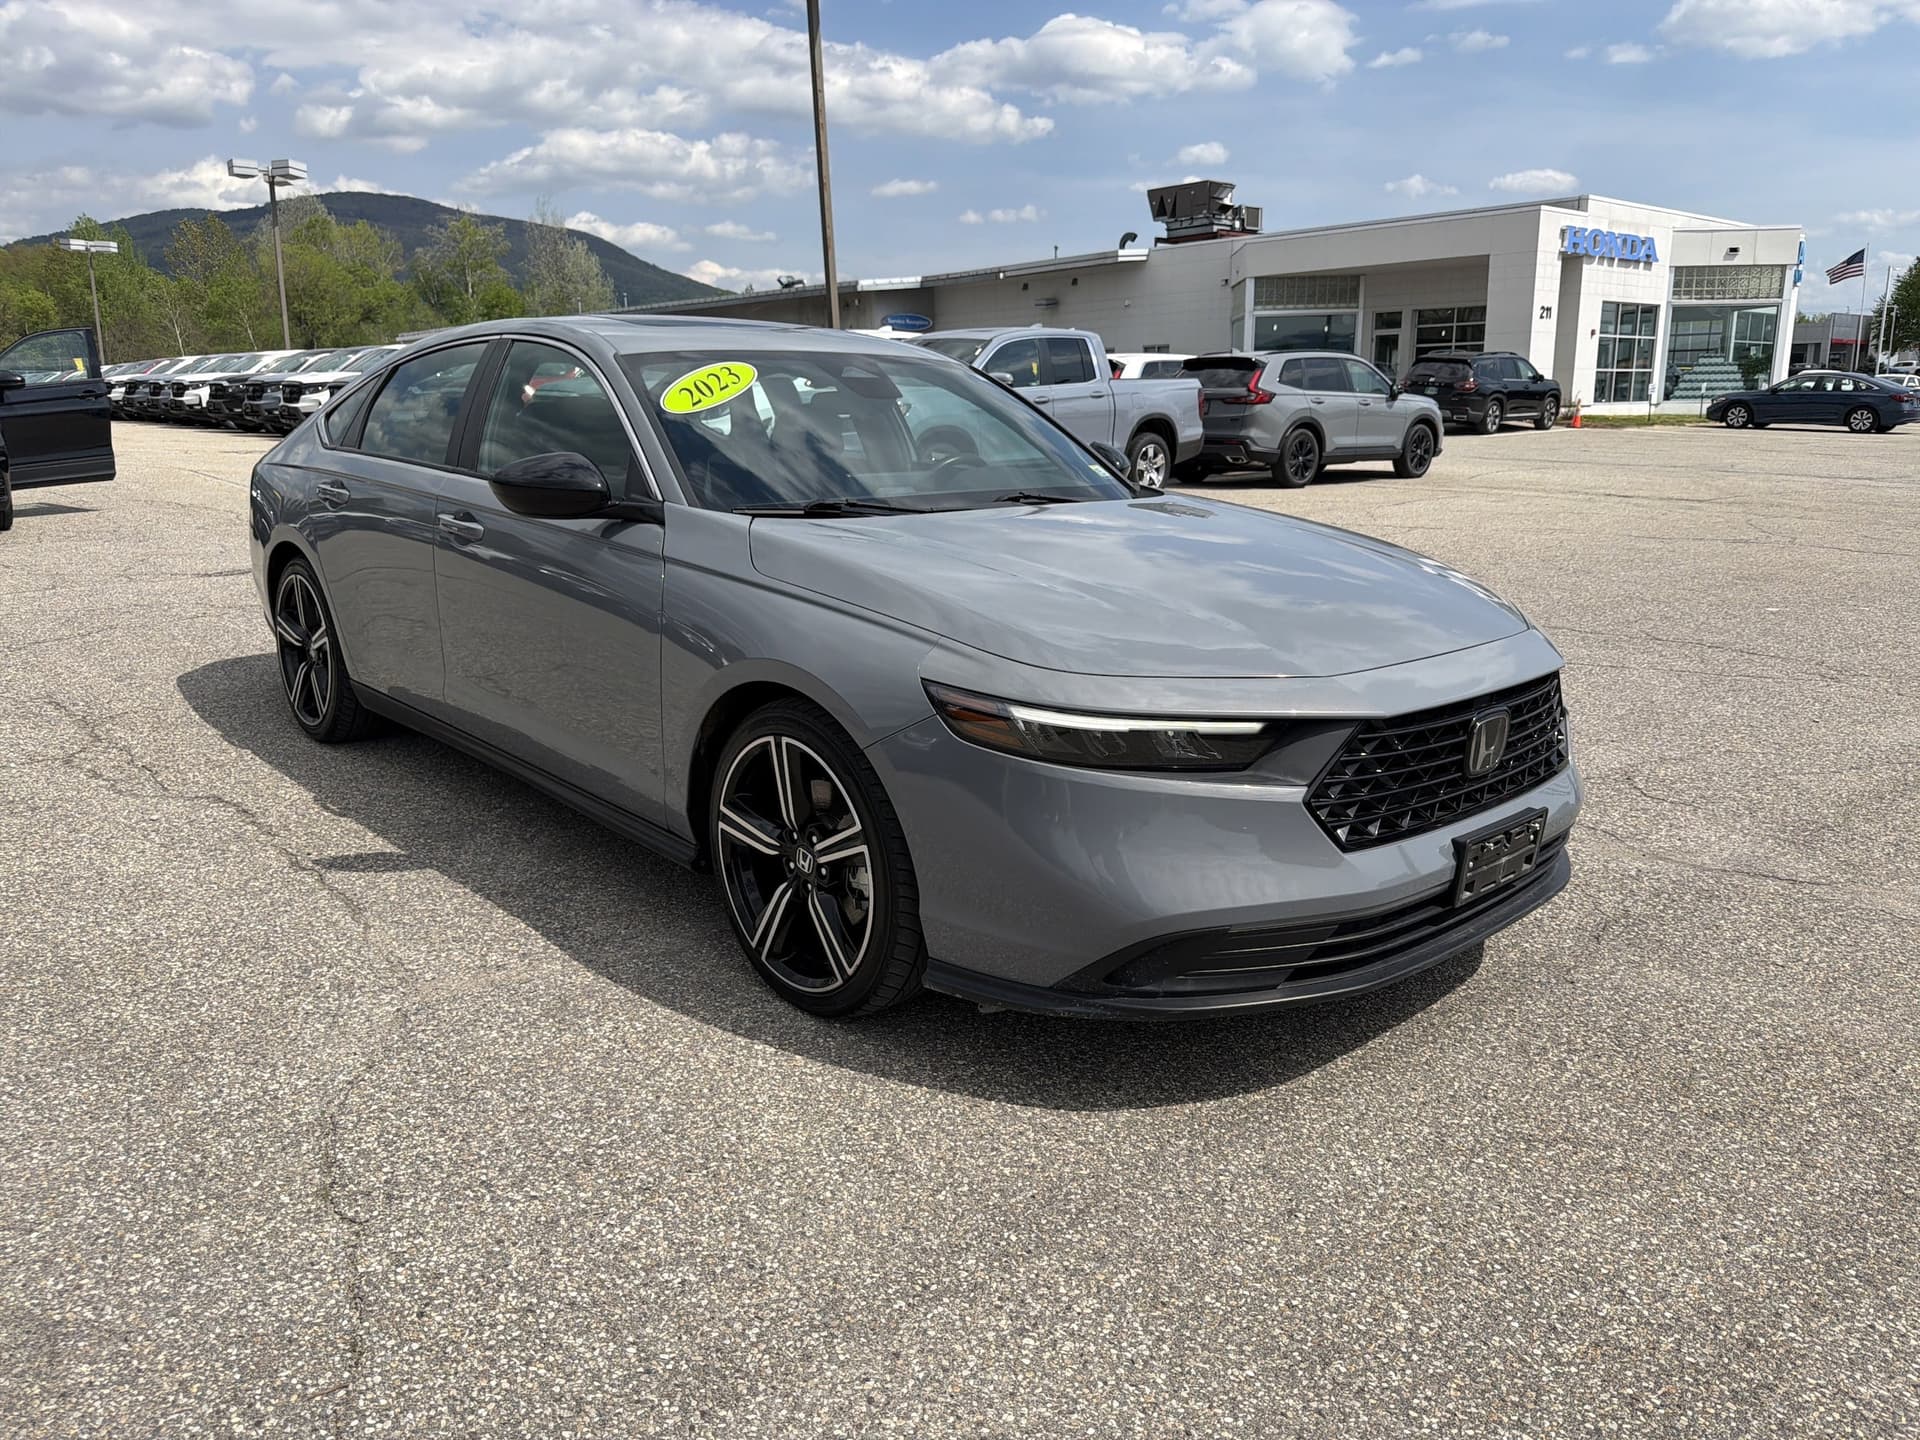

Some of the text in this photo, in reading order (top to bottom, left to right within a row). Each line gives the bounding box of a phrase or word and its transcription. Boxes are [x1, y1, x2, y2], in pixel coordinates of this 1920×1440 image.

[1561, 225, 1659, 263] HONDA
[1539, 305, 1552, 320] 211
[678, 366, 741, 407] 2023
